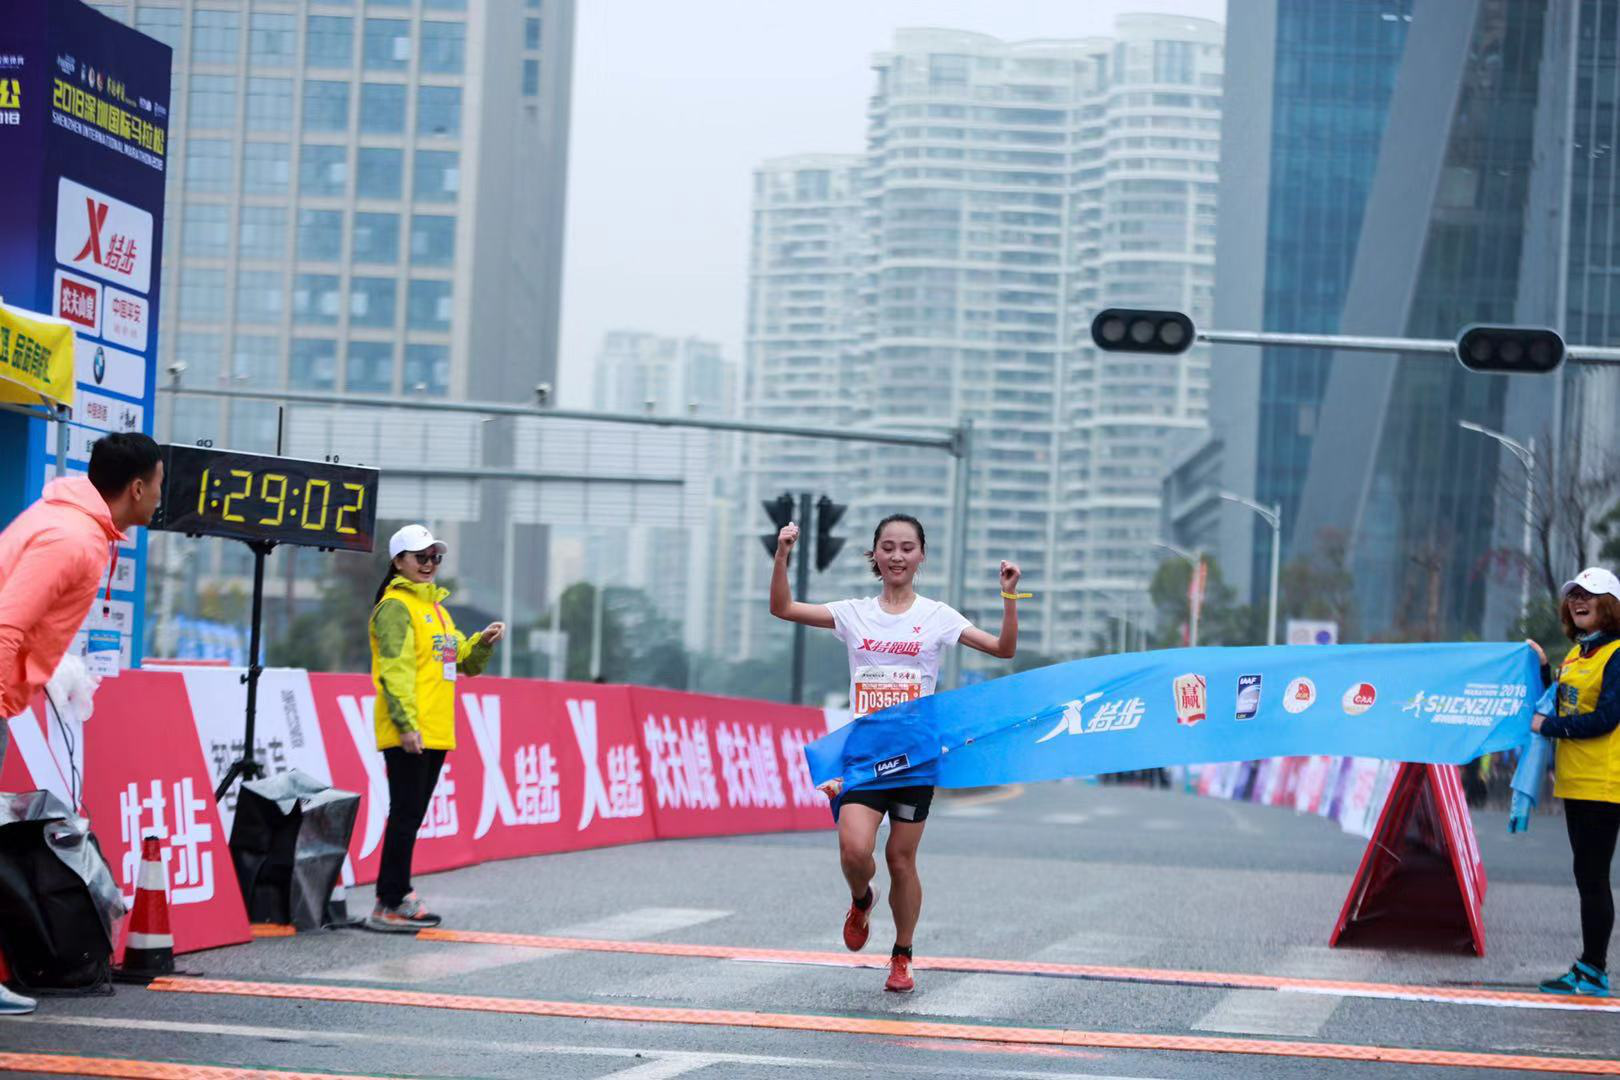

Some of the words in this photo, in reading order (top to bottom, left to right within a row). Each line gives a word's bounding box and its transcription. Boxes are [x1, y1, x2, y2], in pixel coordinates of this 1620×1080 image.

[197, 468, 365, 535] 1:29:02
[1500, 683, 1527, 698] 2018
[877, 758, 902, 772] IAAF
